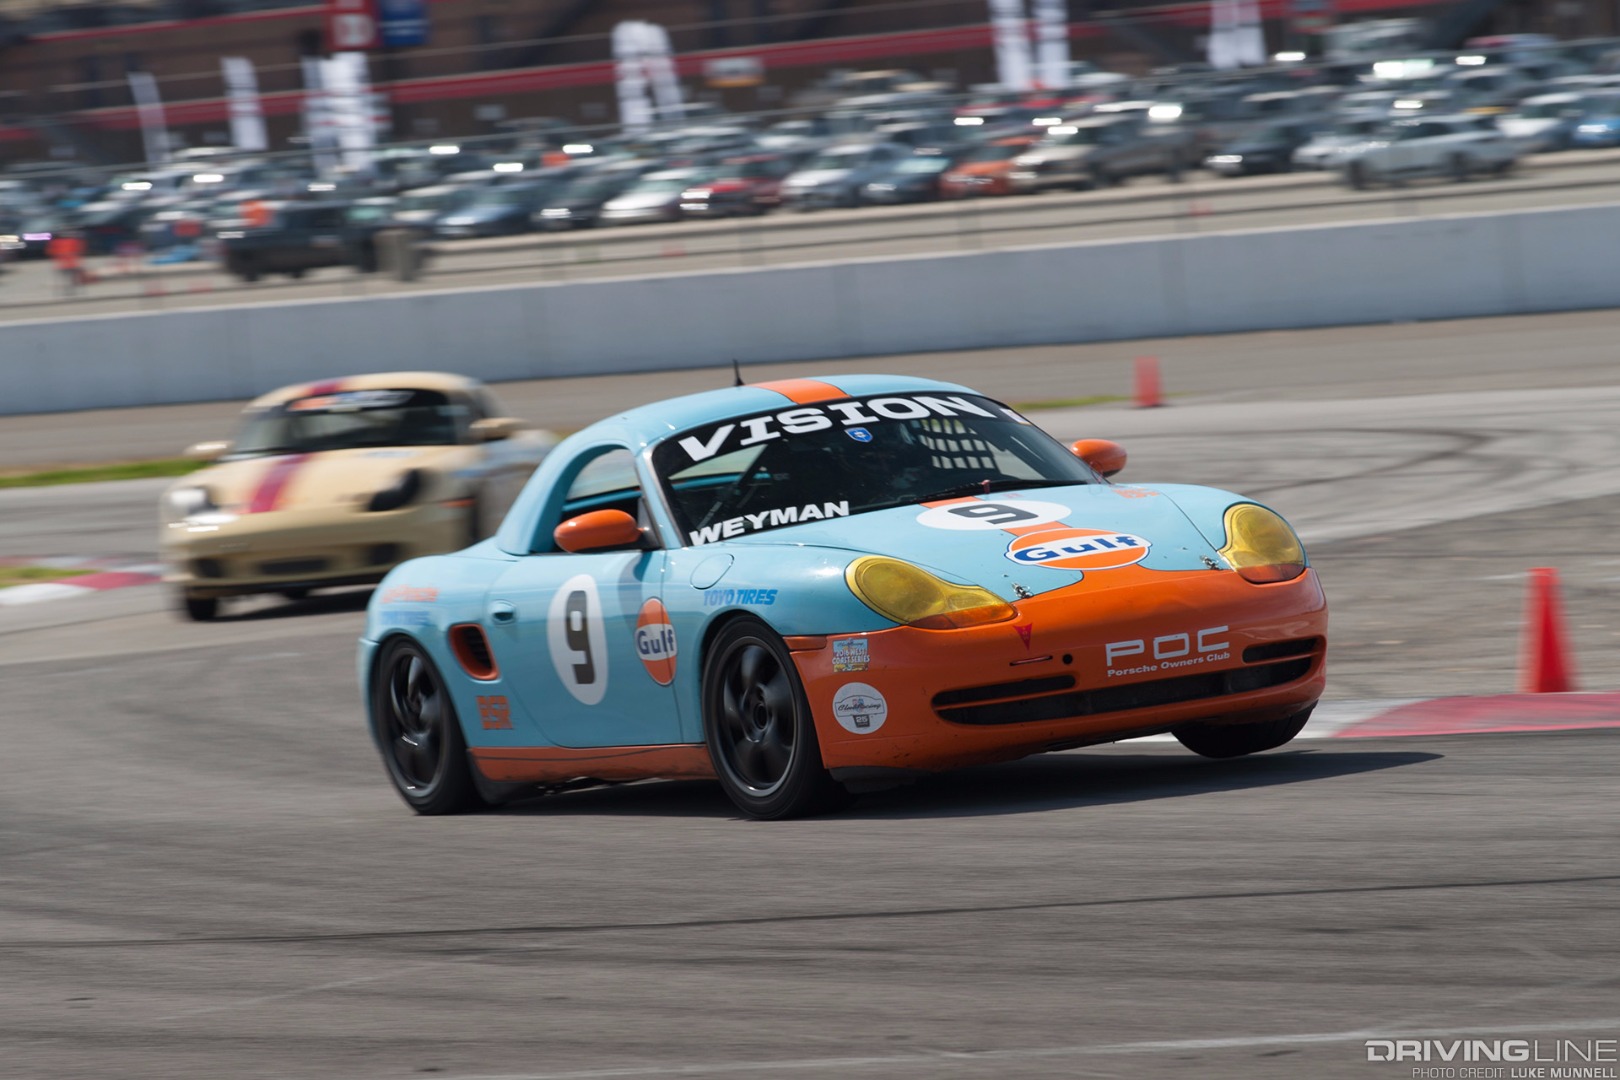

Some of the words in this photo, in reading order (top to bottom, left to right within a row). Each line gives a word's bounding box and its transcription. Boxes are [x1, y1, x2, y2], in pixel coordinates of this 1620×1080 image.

[678, 396, 998, 462] VISION
[689, 500, 850, 547] WEYMAN
[947, 503, 1039, 525] 9
[1013, 535, 1138, 562] Gulf
[703, 589, 735, 606] TOYO
[735, 588, 779, 606] TIRES
[565, 589, 596, 685] 9
[637, 628, 675, 655] Gulf
[1105, 625, 1230, 667] POC
[1106, 664, 1158, 678] Porsche
[1160, 656, 1204, 670] Owners
[1206, 651, 1231, 663] Club
